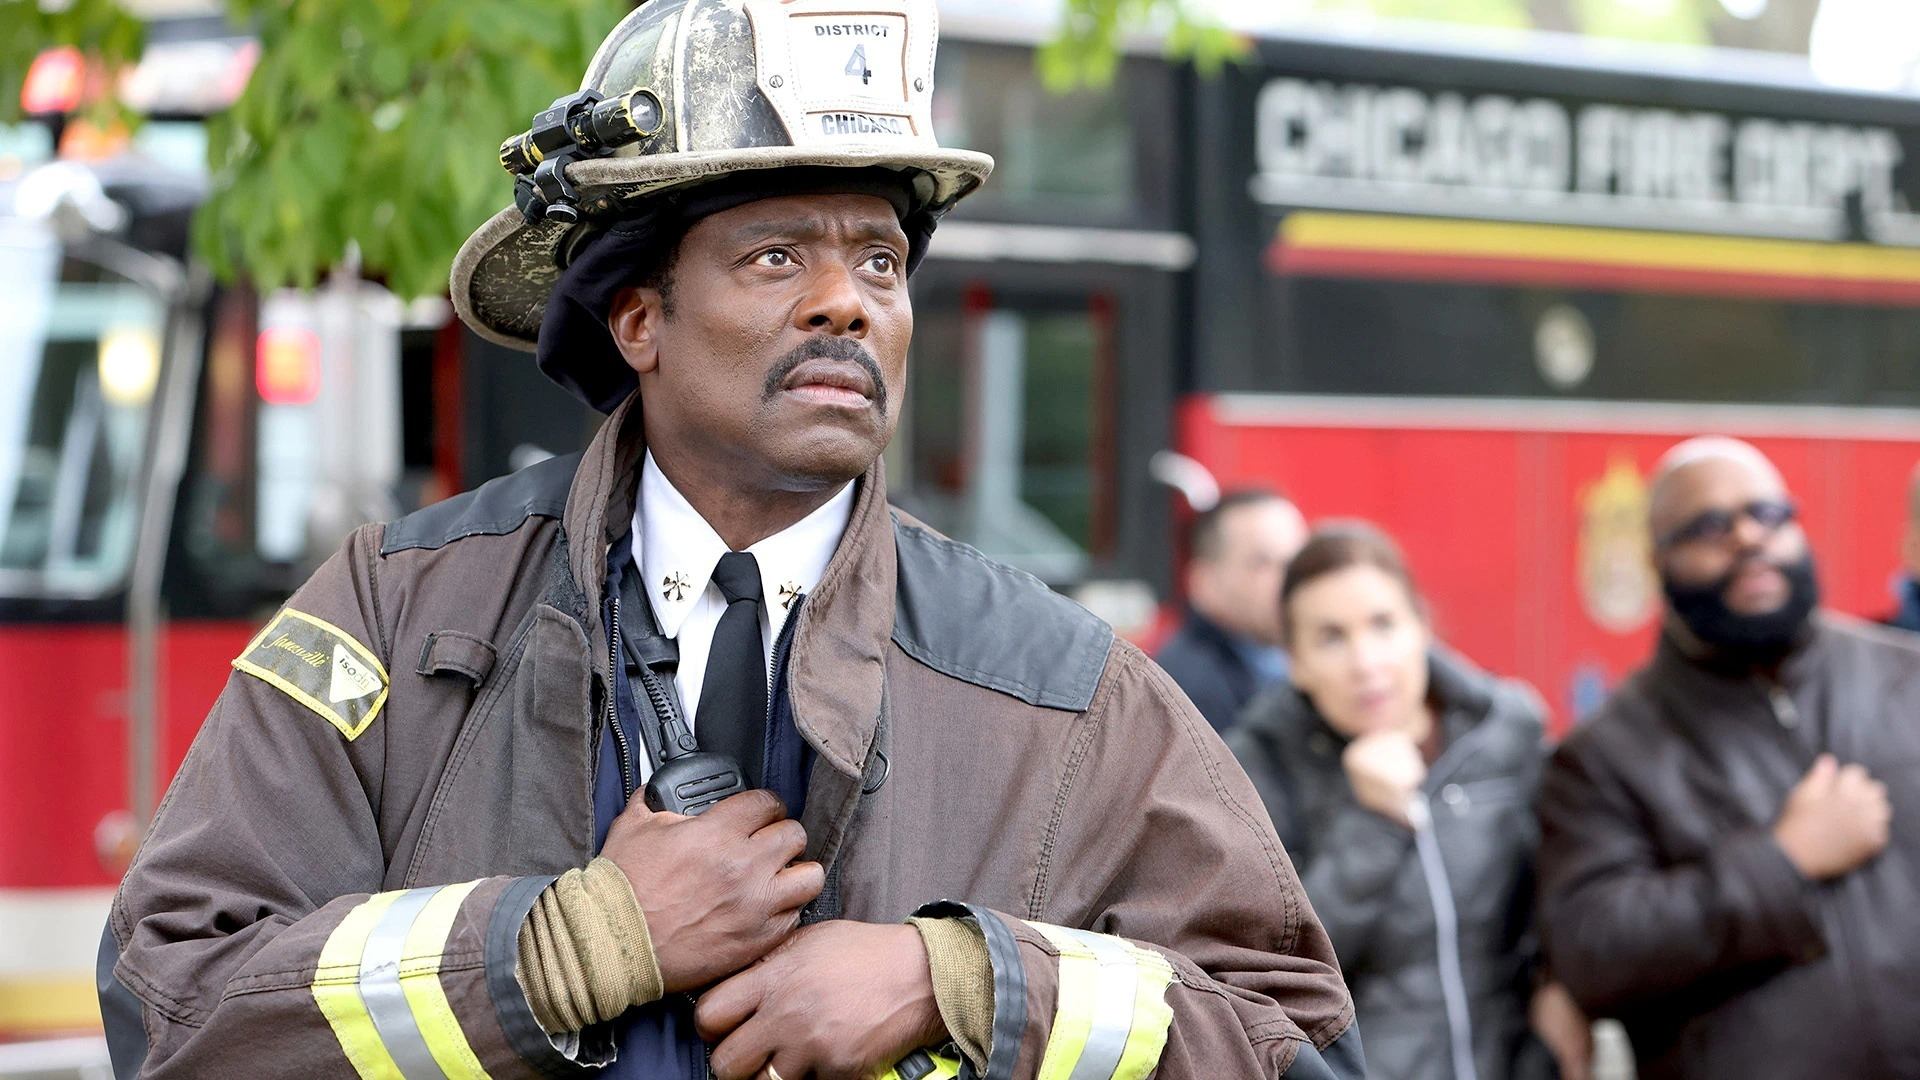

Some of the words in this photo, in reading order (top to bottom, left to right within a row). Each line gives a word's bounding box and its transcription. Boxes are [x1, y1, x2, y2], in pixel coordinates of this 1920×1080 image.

[815, 24, 889, 37] DISTRICT
[845, 44, 872, 85] 4
[1256, 78, 1570, 191] CHICAGO
[1577, 103, 1731, 200] FIRE
